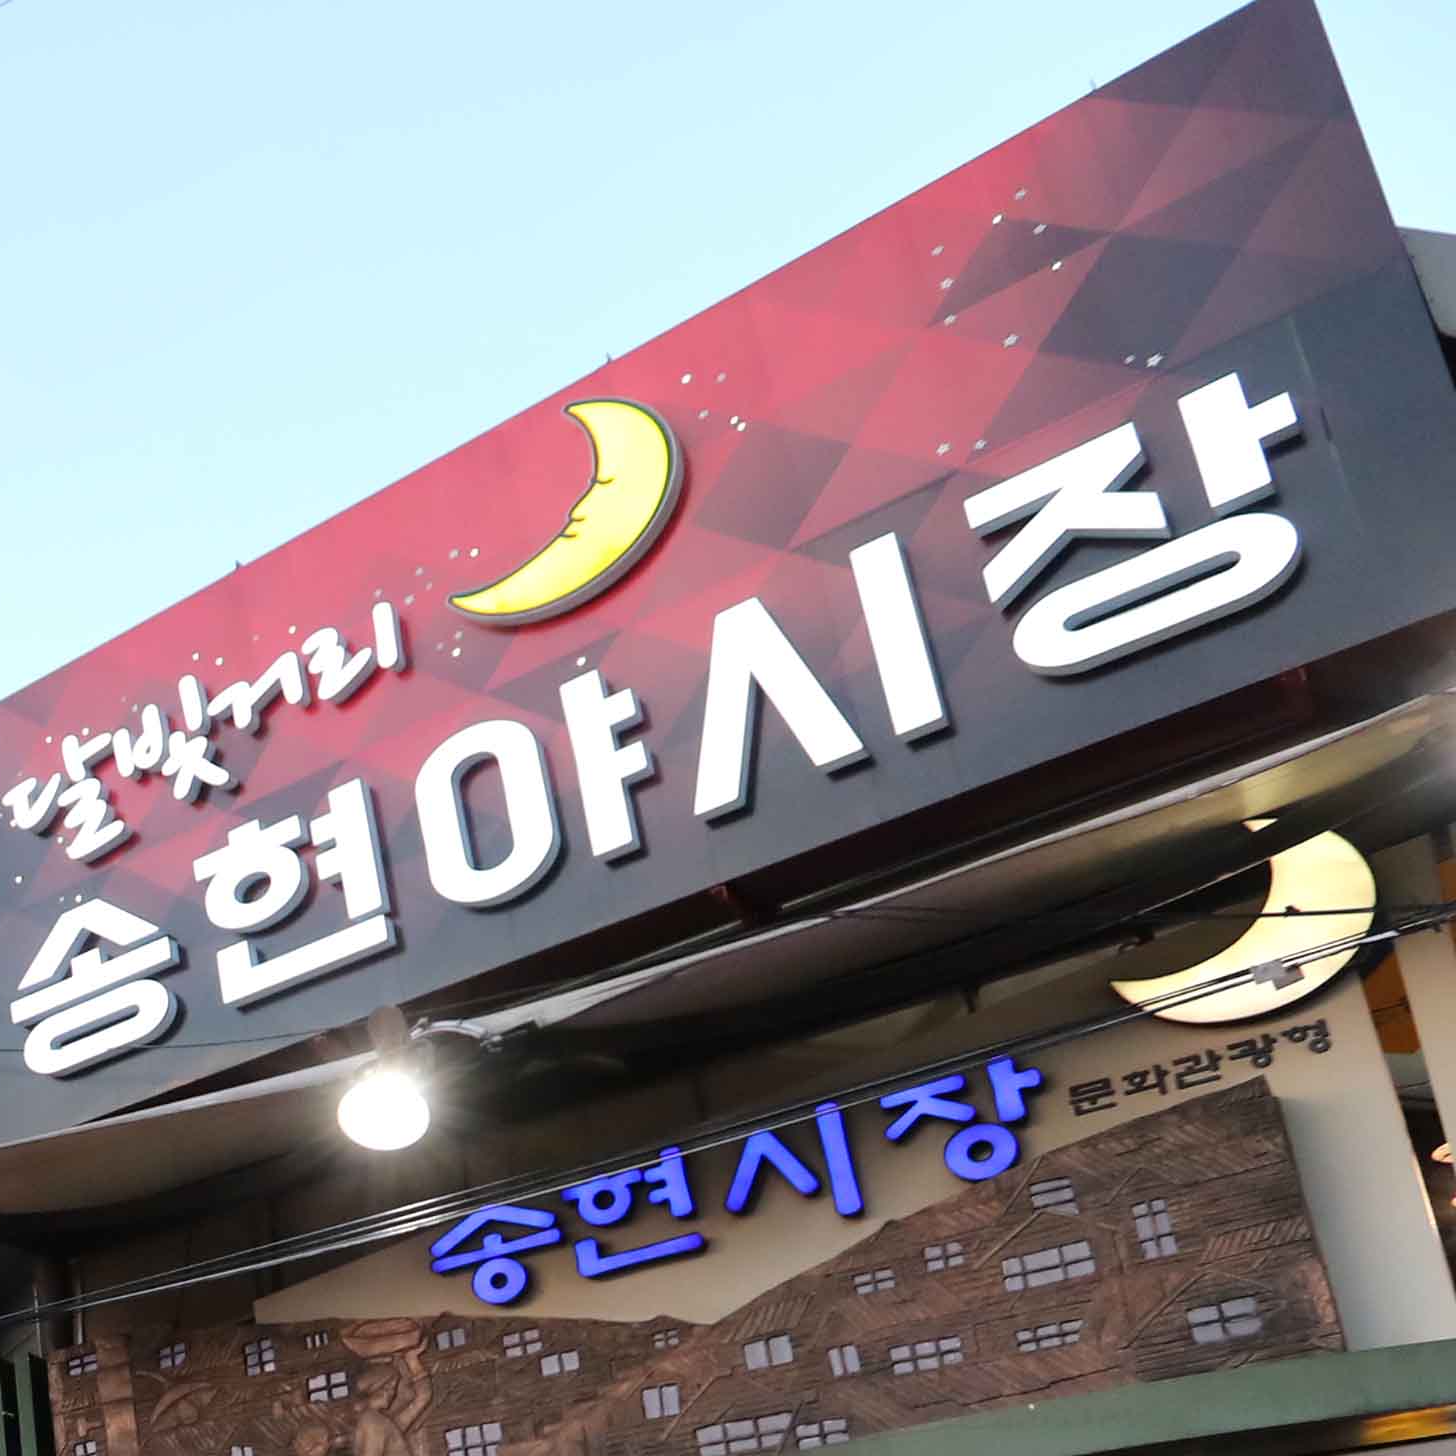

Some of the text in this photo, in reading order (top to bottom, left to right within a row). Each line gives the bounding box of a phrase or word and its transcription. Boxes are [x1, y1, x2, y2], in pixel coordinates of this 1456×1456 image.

[2, 600, 409, 864] 달빛거리
[8, 371, 1304, 1080] 송현야시장
[429, 1054, 1044, 1305] 송현시장
[1068, 1018, 1333, 1117] 문화관광형
